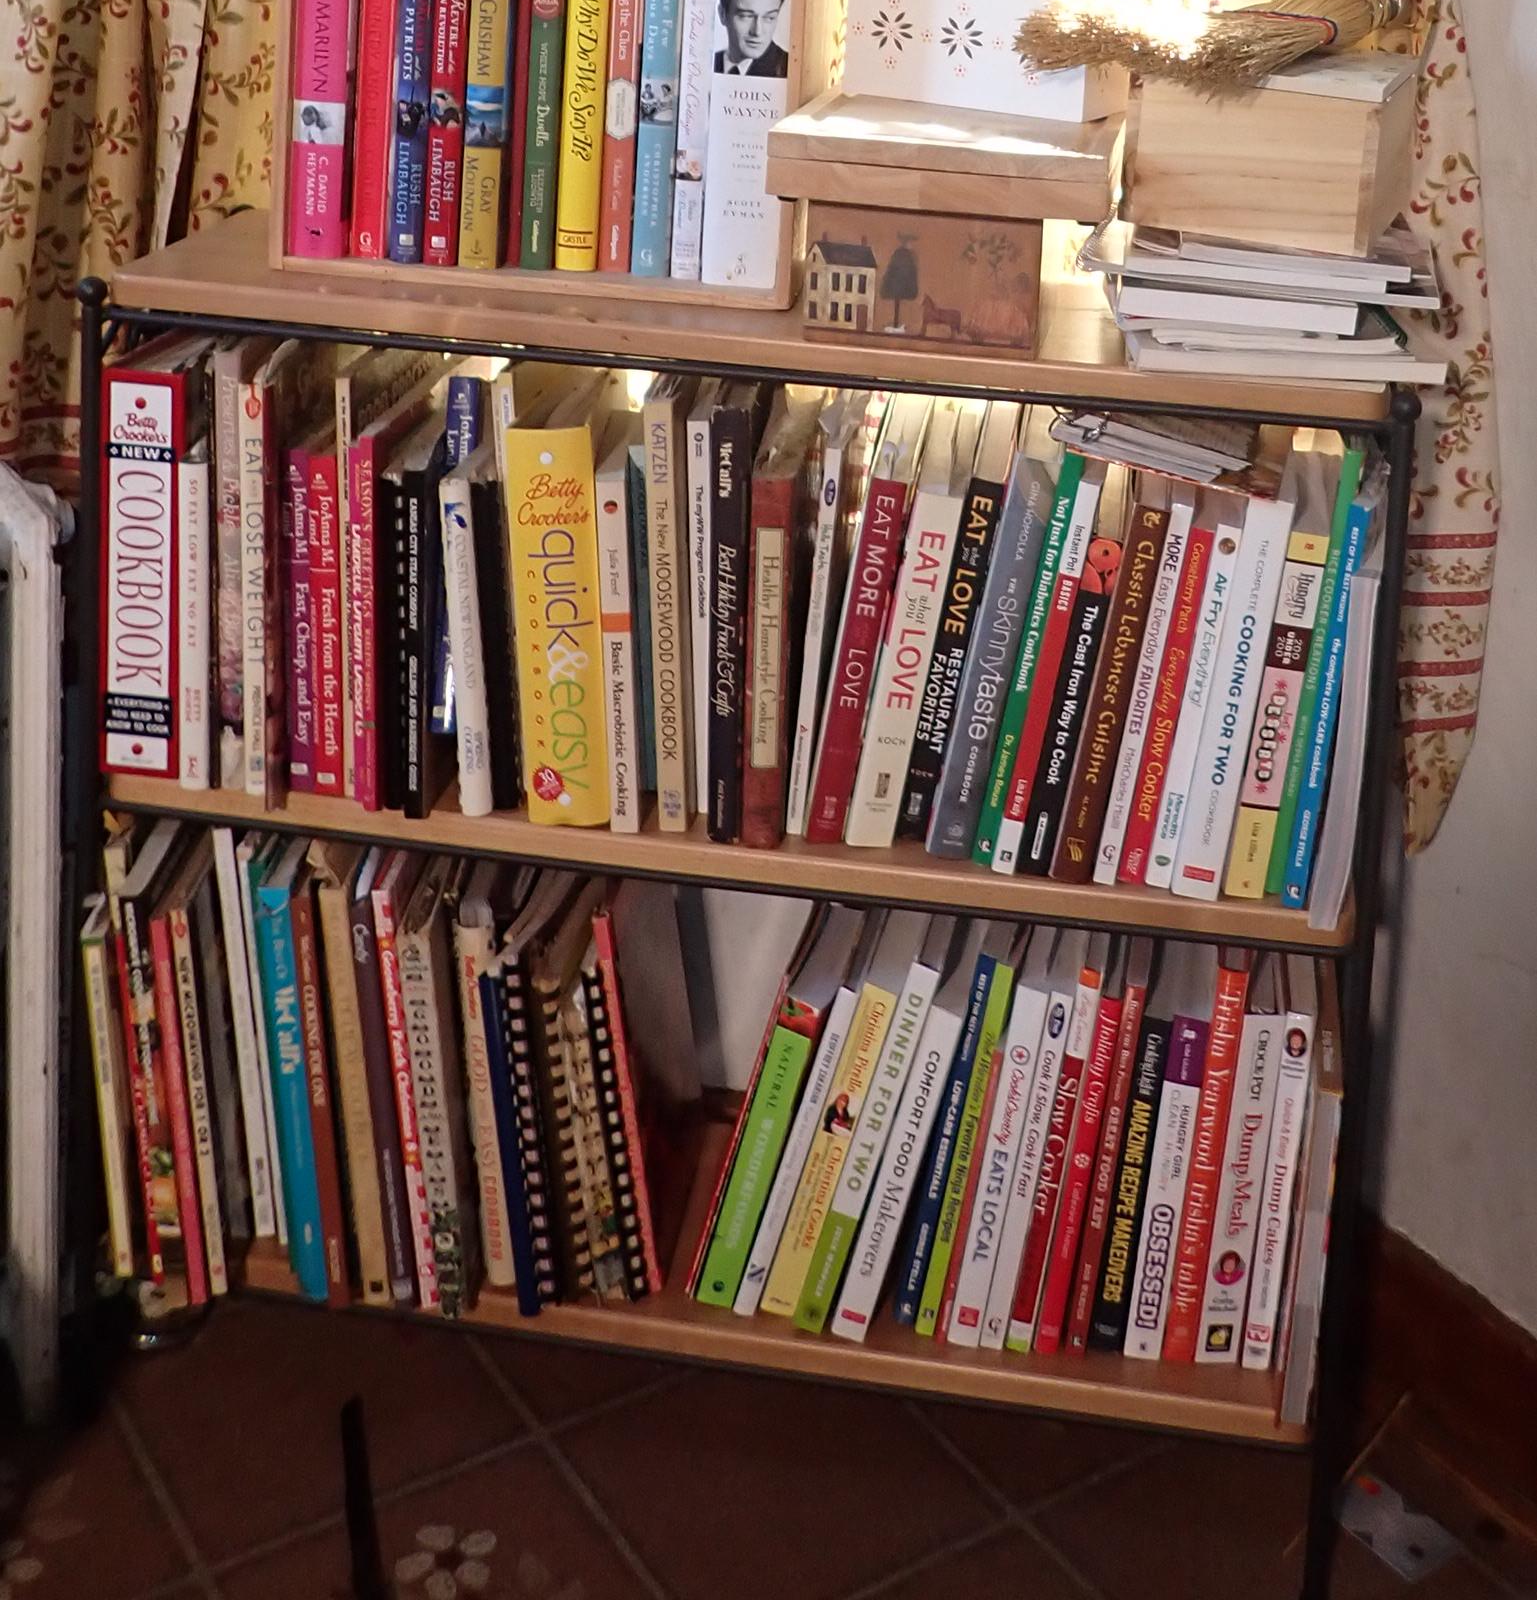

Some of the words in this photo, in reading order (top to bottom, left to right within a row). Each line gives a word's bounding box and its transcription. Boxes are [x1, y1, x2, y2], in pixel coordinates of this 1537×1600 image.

[620, 9, 631, 27] the
[662, 20, 674, 47] Few
[312, 2, 332, 93] MARILYN
[402, 8, 414, 80] PATRIOTS
[576, 29, 598, 62] Do
[618, 30, 630, 60] Clues
[575, 62, 596, 94] We
[729, 89, 772, 102] JOHN
[535, 104, 549, 146] Dwells
[570, 91, 593, 134] Say
[722, 105, 779, 120] WAYNE
[317, 175, 327, 213] DAVID
[396, 142, 410, 224] LIMBAUGH
[409, 164, 423, 205] RUSH
[429, 139, 443, 221] LIMBAUGH
[444, 160, 456, 201] RUSH
[121, 446, 161, 459] NEW
[245, 438, 262, 474] EAT
[651, 423, 668, 483] KATZEN
[525, 473, 585, 500] Betty
[655, 499, 668, 520] The
[1054, 497, 1069, 516] Not
[246, 501, 263, 556] LOSE
[656, 523, 669, 549] New
[872, 495, 894, 538] EAT
[966, 495, 992, 544] EAT
[1049, 519, 1066, 546] Just
[1069, 525, 1086, 553] Instant
[718, 544, 735, 572] Best
[912, 530, 945, 592] EAT
[1123, 541, 1154, 608] Classic
[1163, 534, 1183, 572] MORE
[116, 470, 166, 686] COOKBOOK
[528, 530, 593, 650] quick
[712, 573, 736, 623] Holiday
[758, 555, 780, 608] Healthy
[856, 544, 888, 616] MORE
[944, 568, 975, 635] LOVE
[1028, 569, 1054, 627] Diabetics
[1056, 580, 1073, 611] BASICS
[1156, 576, 1175, 604] Easy
[1212, 572, 1229, 597] Air
[247, 567, 265, 665] WEIGHT
[322, 588, 336, 629] Fresh
[655, 552, 674, 663] MOOSEWOOD
[904, 596, 919, 619] you
[914, 595, 930, 624] what
[1081, 605, 1097, 630] The
[1205, 600, 1225, 629] Fry
[322, 634, 336, 668] from
[611, 641, 625, 675] Basic
[717, 625, 734, 661] Foods
[758, 614, 778, 685] Homestyle
[1072, 633, 1093, 665] Cast
[1104, 614, 1139, 704] Lebanese
[1144, 608, 1169, 662] Everyday
[1227, 614, 1256, 698] COOKING
[323, 673, 337, 697] the
[547, 647, 590, 683] &
[839, 648, 869, 710] LOVE
[886, 627, 925, 711] LOVE
[967, 595, 1016, 741] skinnytaste
[1015, 630, 1039, 692] Cookbook
[1064, 668, 1085, 697] Iron
[296, 679, 309, 705] and
[660, 669, 677, 760] COOKBOOK
[757, 689, 776, 744] Cooking
[916, 653, 946, 740] FAVORITES
[928, 648, 963, 754] RESTAURANT
[1055, 700, 1077, 728] Way
[1128, 665, 1154, 735] FAVORITES
[293, 710, 311, 745] Easy
[324, 701, 338, 755] Hearth
[539, 679, 589, 790] easy
[613, 680, 627, 758] Macrobiotic
[1055, 730, 1070, 745] to
[1148, 717, 1173, 757] Slow
[1218, 703, 1239, 740] FOR
[1046, 749, 1067, 785] Cook
[1084, 711, 1118, 784] Cuisine
[1210, 744, 1231, 786] TWO
[613, 762, 629, 816] Cooking
[1137, 762, 1165, 822] Cooker
[859, 1001, 888, 1053] Christina
[883, 992, 924, 1079] DINNER
[1213, 990, 1242, 1057] Trisha
[848, 1055, 871, 1094] Pirello
[906, 1049, 941, 1129] COMFORT
[1038, 1050, 1056, 1080] Cook
[866, 1086, 893, 1133] FOR
[1051, 1073, 1078, 1129] Slow
[1194, 1067, 1232, 1170] Yearwood
[893, 1130, 918, 1178] FOOD
[1023, 1129, 1042, 1157] Cook
[1122, 1099, 1151, 1164] AMAZING
[1231, 1113, 1263, 1175] Dump
[815, 1145, 844, 1204] Christina
[848, 1141, 874, 1193] TWO
[986, 1149, 1009, 1196] EATS
[1014, 1171, 1032, 1198] Fast
[1032, 1134, 1065, 1216] Cooker
[1117, 1166, 1144, 1215] RECIPE
[1267, 1163, 1288, 1212] Dump
[801, 1207, 825, 1250] Cooks
[859, 1179, 906, 1277] Makeovers
[972, 1200, 998, 1262] LOCAL
[1183, 1182, 1210, 1255] trisha's
[1227, 1179, 1251, 1237] Meals
[1103, 1217, 1133, 1302] MAKEOVERS
[1262, 1216, 1282, 1264] Cakes
[1136, 1204, 1174, 1331] OBSESSED!
[1176, 1261, 1199, 1313] table
